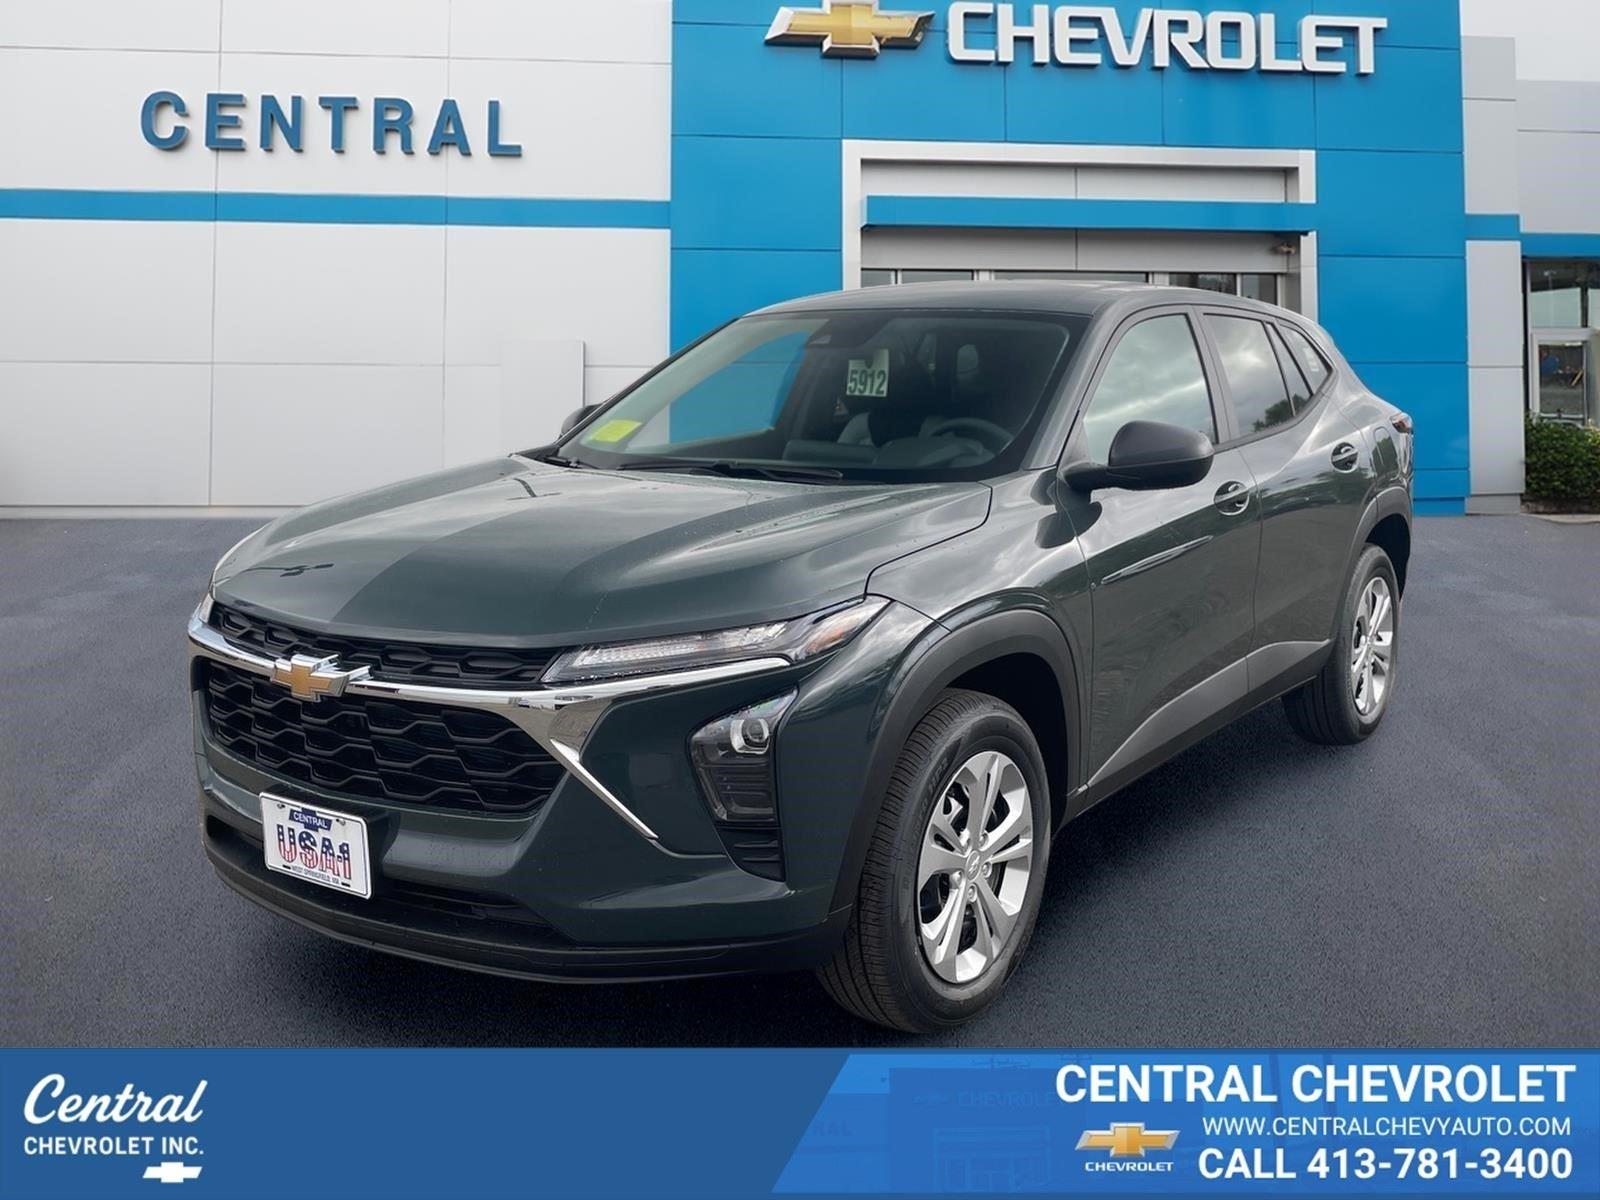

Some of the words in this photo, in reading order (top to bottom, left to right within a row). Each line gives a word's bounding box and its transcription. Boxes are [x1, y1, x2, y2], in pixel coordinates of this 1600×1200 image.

[947, 0, 1388, 75] CHEVROLET
[140, 90, 522, 157] CENTRAL
[848, 368, 887, 396] 5912
[293, 811, 329, 829] CENTRAL
